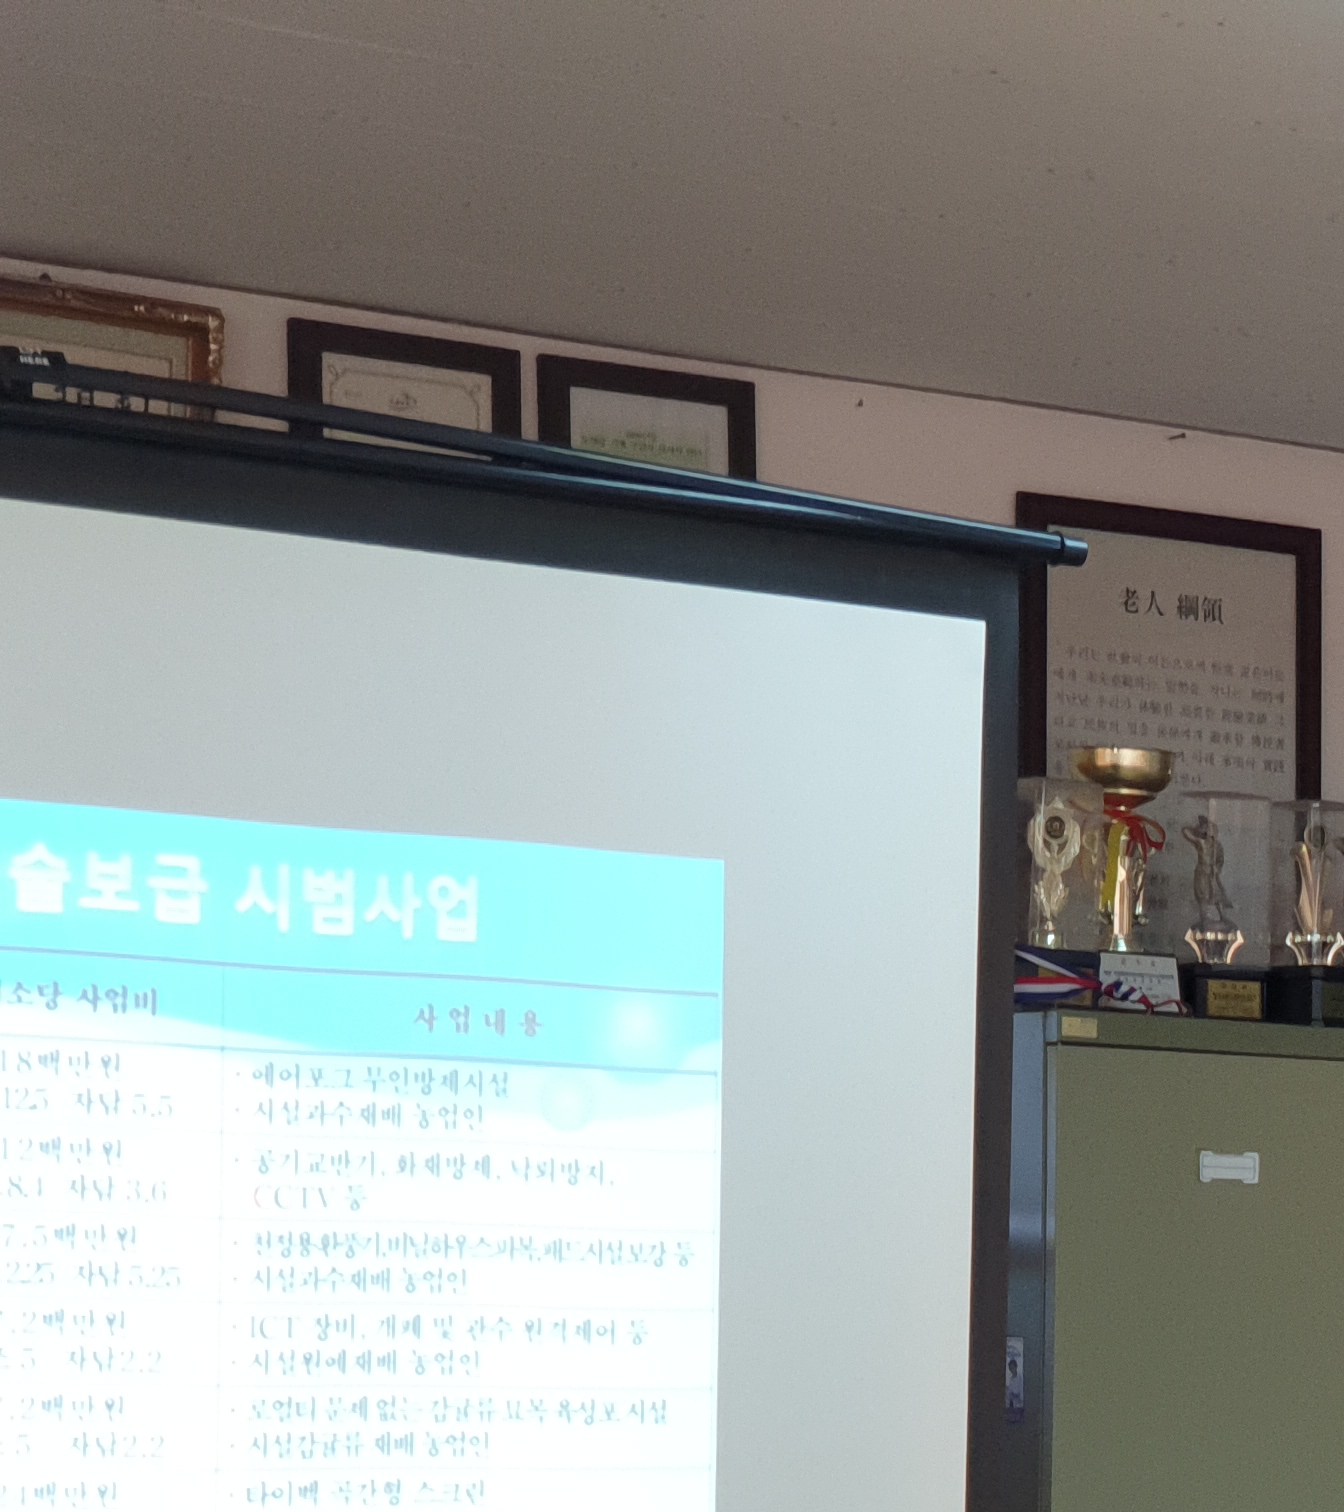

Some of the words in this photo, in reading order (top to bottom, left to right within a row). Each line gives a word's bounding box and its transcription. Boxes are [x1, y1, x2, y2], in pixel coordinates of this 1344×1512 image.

[234, 862, 480, 943] 시범사업
[77, 984, 158, 1017] 사업비
[417, 1103, 482, 1131] 농업인
[403, 1267, 466, 1294] 농업인
[412, 1350, 479, 1376] 농업인
[628, 1399, 666, 1424] 시설
[426, 1431, 488, 1457] 농업인
